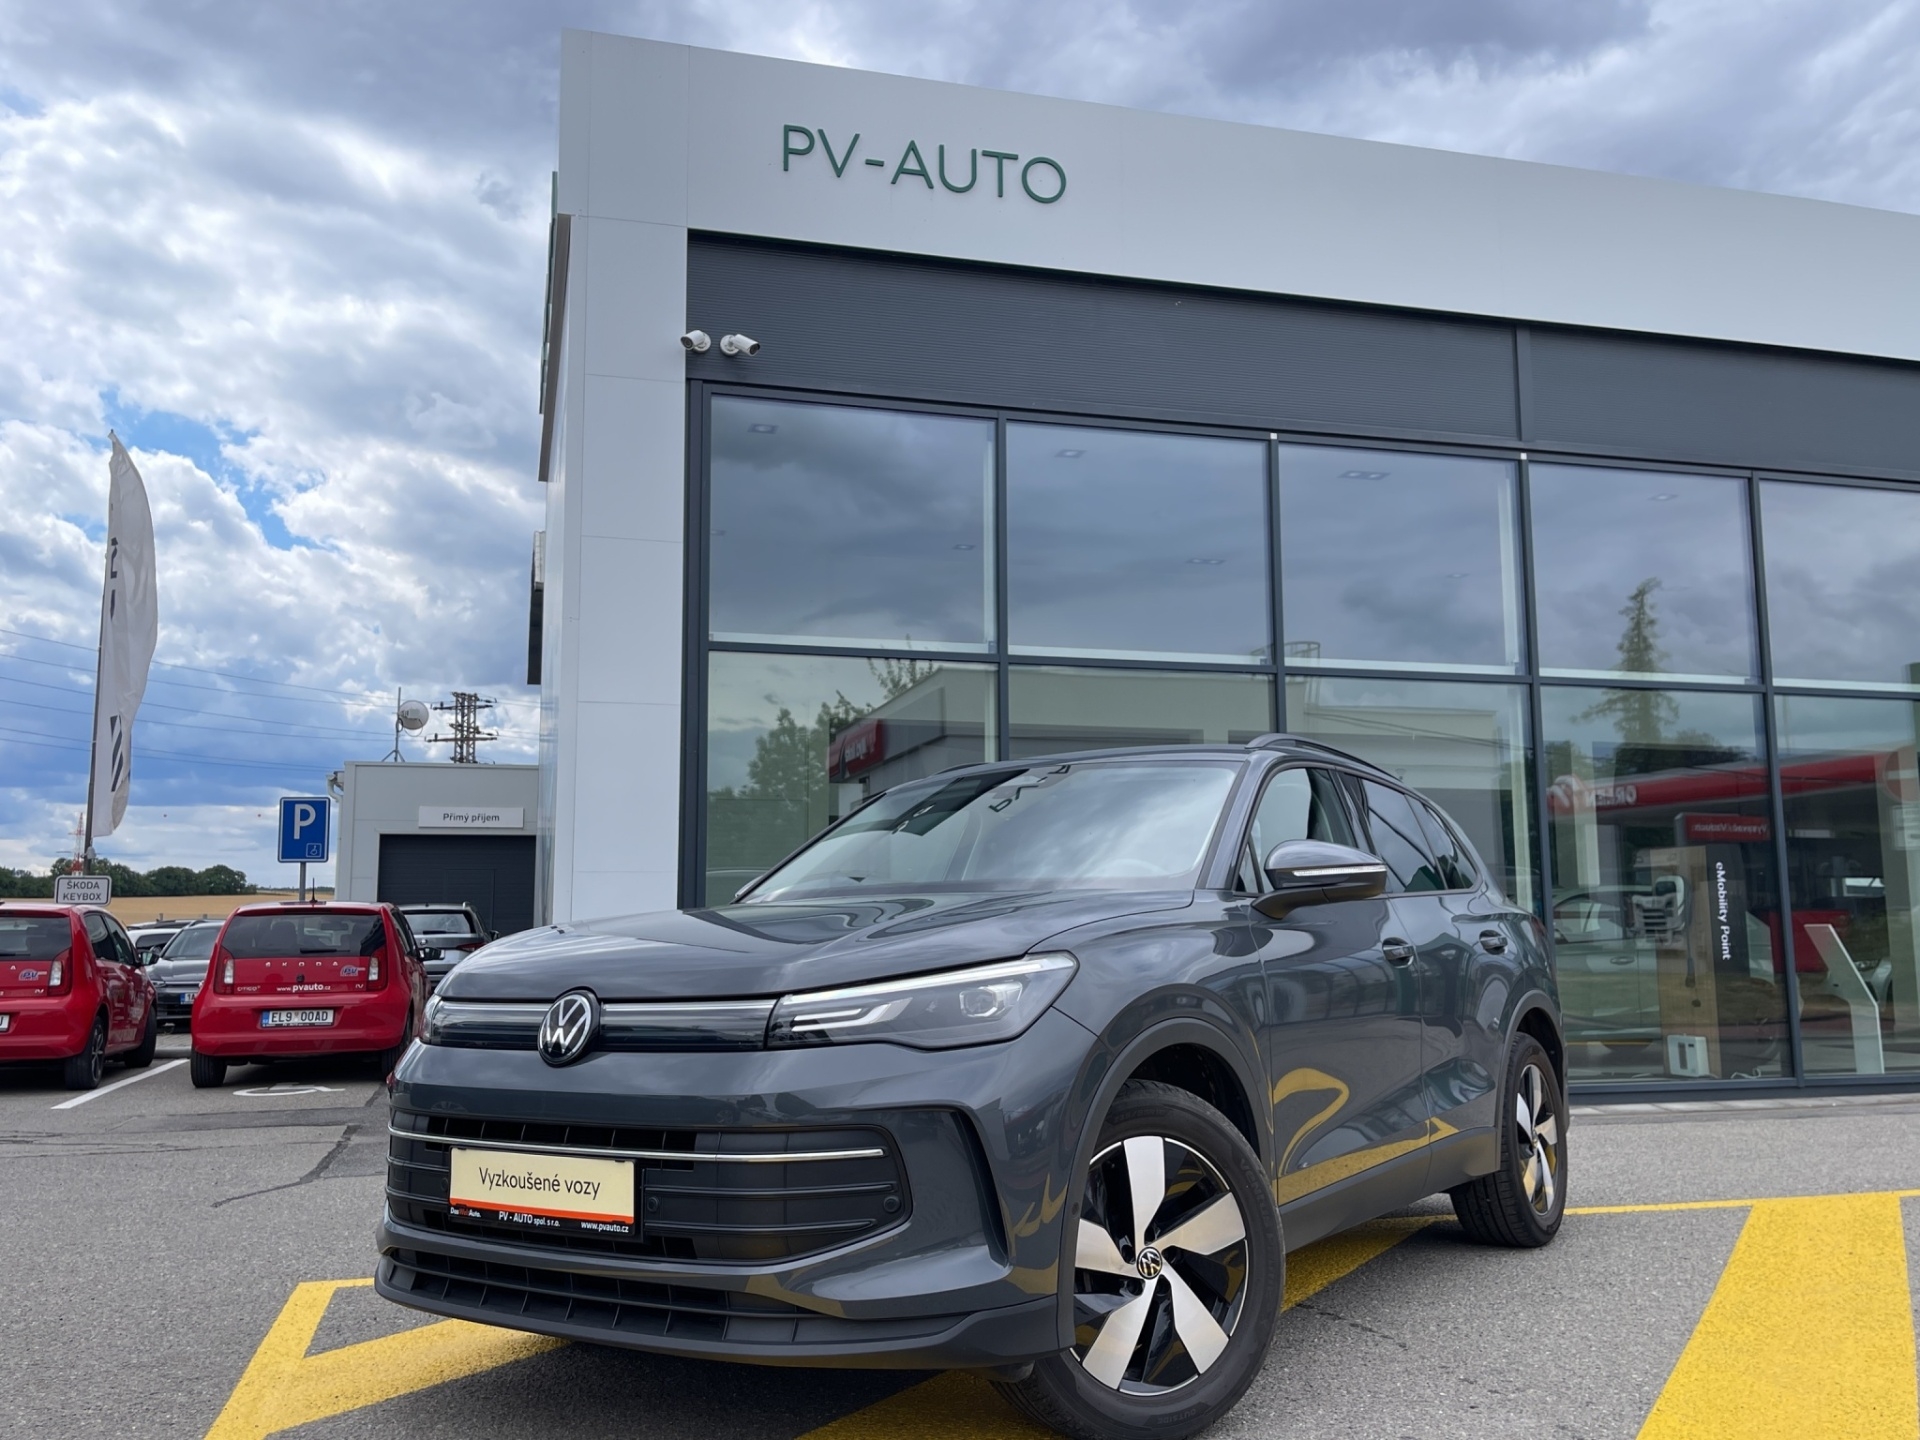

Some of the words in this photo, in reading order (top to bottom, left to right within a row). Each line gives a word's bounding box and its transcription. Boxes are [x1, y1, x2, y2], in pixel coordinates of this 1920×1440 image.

[783, 123, 1067, 204] PV-AUTO
[293, 803, 317, 840] P
[66, 880, 100, 890] ŠKODA
[1715, 861, 1729, 923] eMobility
[62, 892, 102, 901] KEYBOX
[1720, 925, 1731, 960] Point
[276, 983, 331, 993] www.pvauto.cz
[271, 1011, 293, 1023] EL9
[479, 1167, 561, 1193] Vyzkoušené
[565, 1179, 601, 1200] vozy
[498, 1210, 509, 1221] PV
[513, 1212, 533, 1224] AUTO
[580, 1221, 629, 1233] www.pvauto.cz
